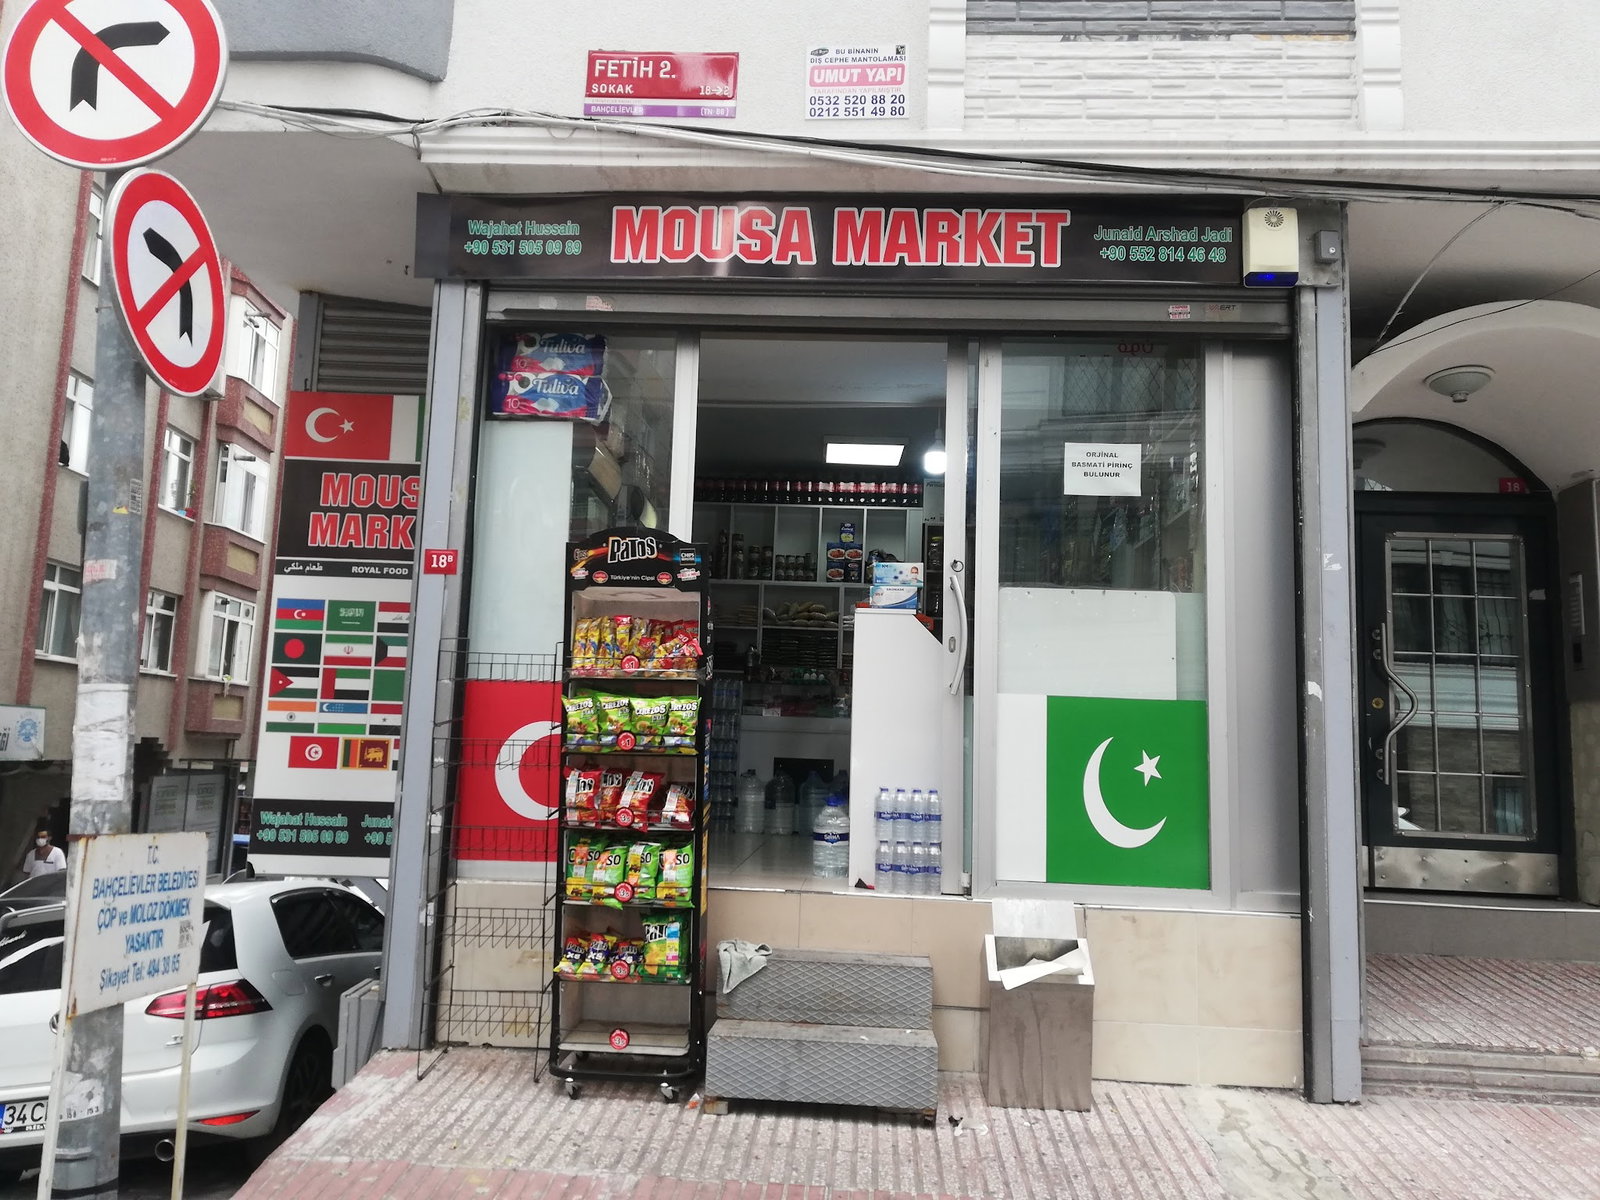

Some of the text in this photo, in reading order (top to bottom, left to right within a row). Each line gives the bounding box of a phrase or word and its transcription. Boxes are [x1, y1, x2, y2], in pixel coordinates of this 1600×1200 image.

[594, 57, 676, 79] FETİH 2.
[813, 67, 902, 83] UMUT YAPI
[591, 83, 634, 94] SOKAK
[809, 94, 905, 106] 0532 520 88 20
[591, 105, 644, 114] BAHÇELİEVLER
[809, 106, 905, 117] 0212 551 49 80
[468, 220, 580, 237] Wajahat Hussain
[610, 205, 1071, 267] MOUSA MARKET
[1094, 225, 1233, 243] Junaid Arshad Jadi
[464, 240, 582, 255] +90 531 505 09 89
[1100, 245, 1227, 263] +90 552 814 46 48
[540, 339, 585, 354] Tuliva
[533, 379, 579, 395] Tuliva
[506, 398, 520, 409] 10
[319, 472, 420, 510] MOUS
[1507, 482, 1520, 492] 18
[308, 511, 416, 550] MARK
[351, 565, 409, 575] ROYAL FOOD
[260, 811, 303, 828] Wajahat
[304, 812, 347, 828] Hussain
[256, 828, 276, 843] +90
[278, 829, 297, 843] 531
[299, 829, 319, 843] 505
[320, 830, 333, 844] 09
[364, 831, 384, 845] +90
[385, 831, 393, 845] 5
[92, 867, 199, 900] BAHÇELİEVLER BELEDİYESİ
[97, 896, 190, 934] ÇÖP ve MOLOZ DÖKMEK
[125, 928, 164, 955] YASAKTIR
[99, 966, 130, 993] Şikayet
[4, 1104, 27, 1125] 34
[30, 1102, 48, 1122] C
